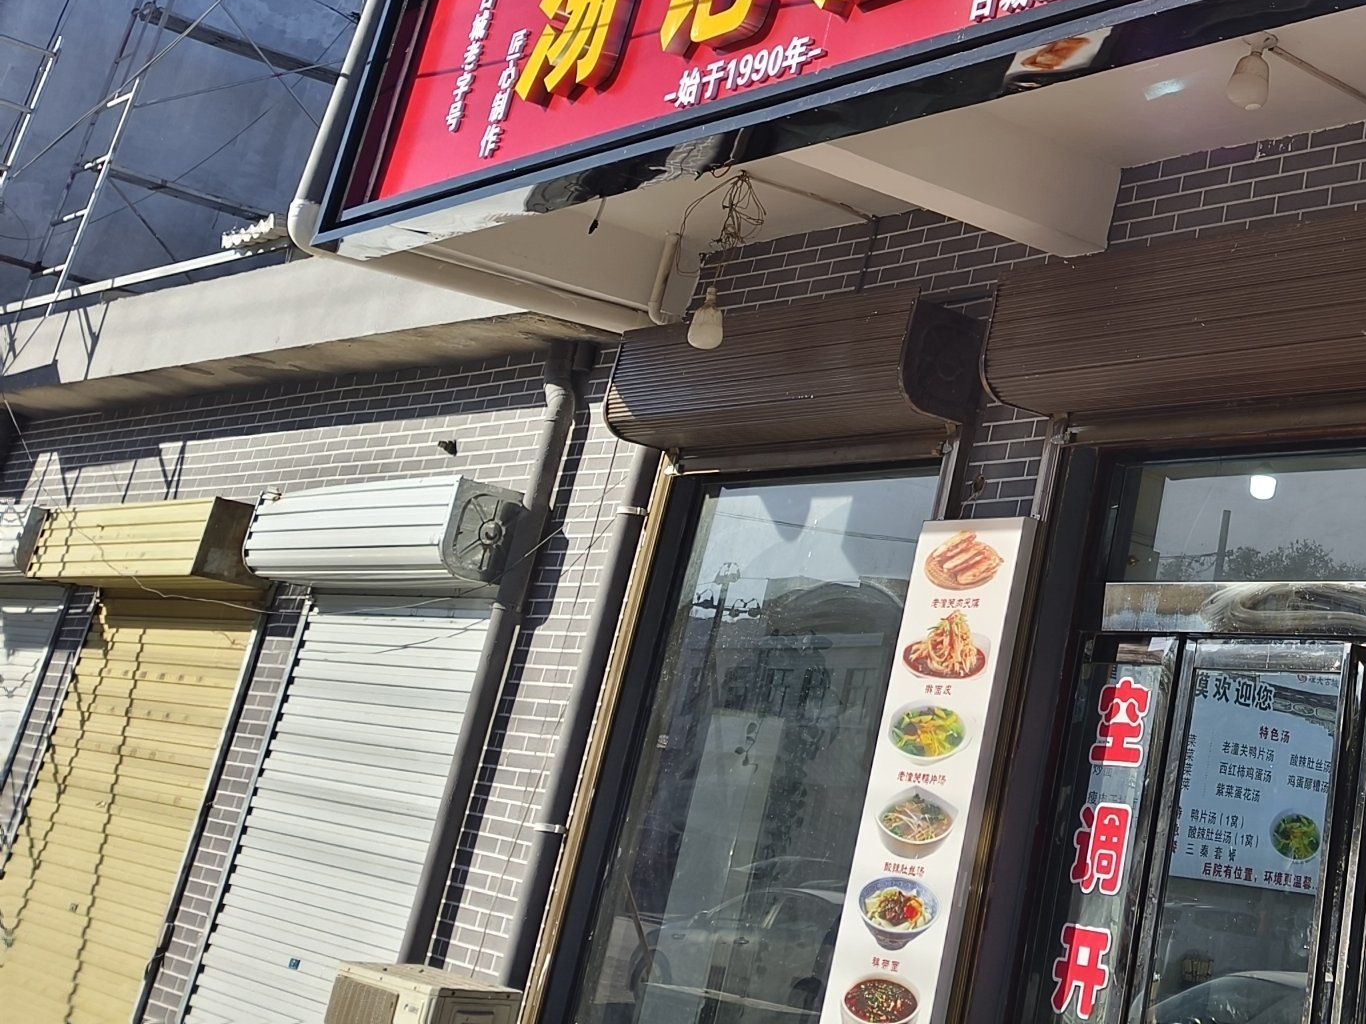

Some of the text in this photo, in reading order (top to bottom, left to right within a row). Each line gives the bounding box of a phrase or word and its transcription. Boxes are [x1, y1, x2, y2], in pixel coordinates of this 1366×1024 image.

[479, 28, 528, 159] 匠心制作
[1259, 725, 1291, 744] 特色汤
[1222, 741, 1275, 762] 老潼关鸭片汤
[1219, 761, 1272, 783] 西红柿鸡蛋汤
[1215, 782, 1261, 803] 紫菜蛋花汤
[1051, 676, 1152, 1020] 空调开
